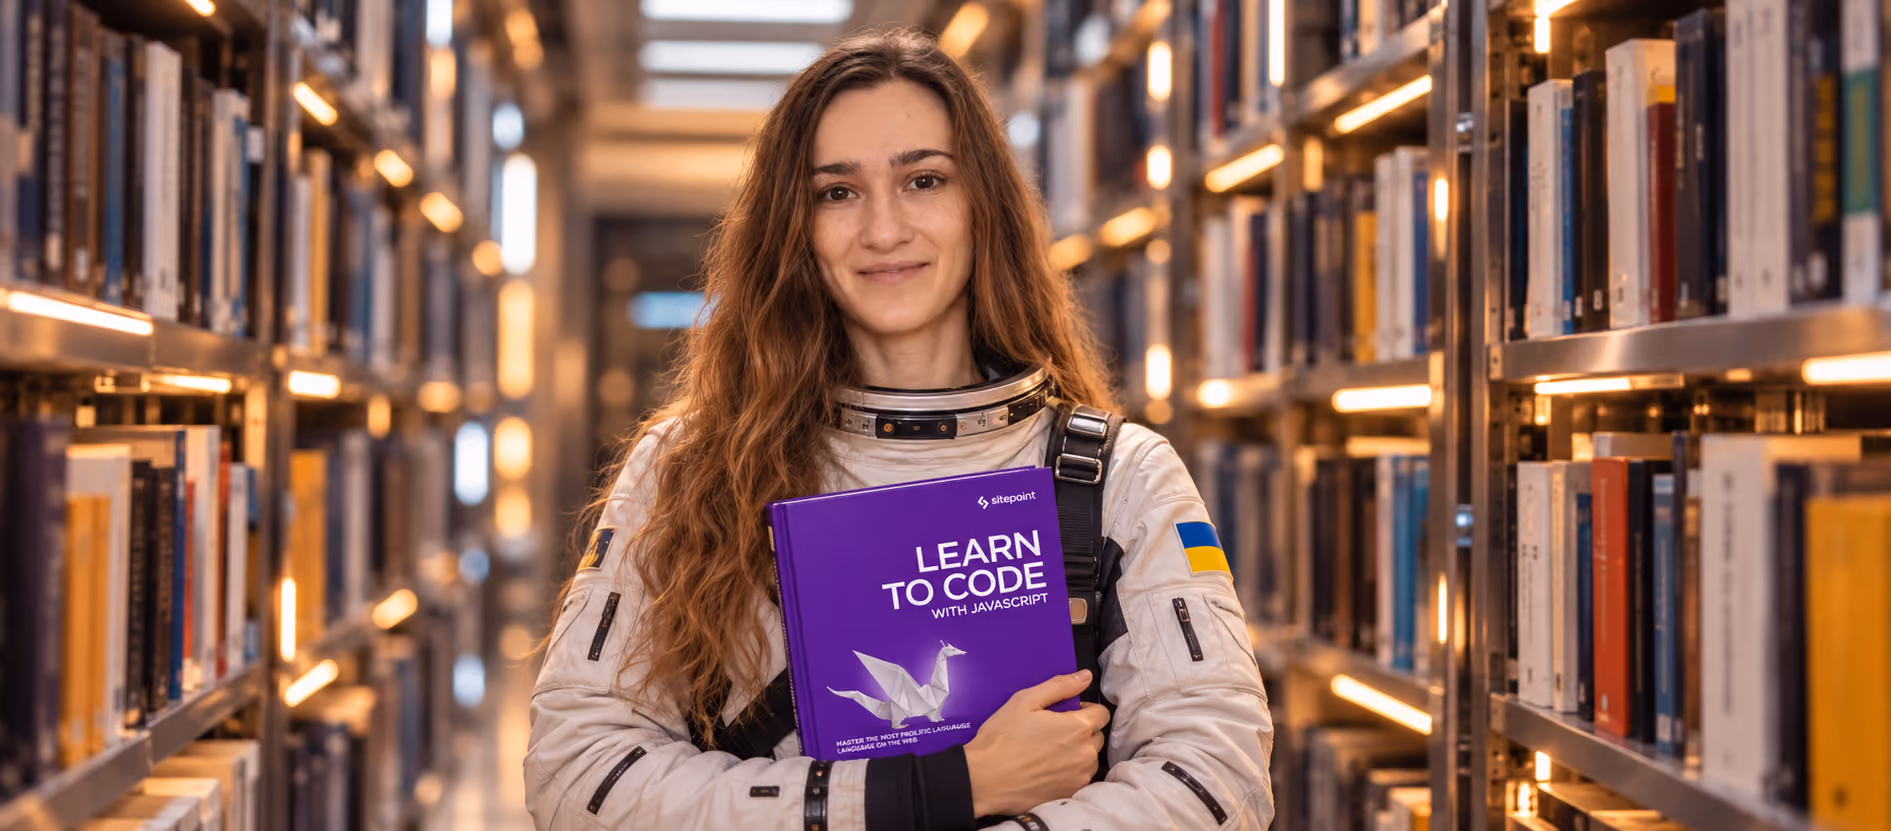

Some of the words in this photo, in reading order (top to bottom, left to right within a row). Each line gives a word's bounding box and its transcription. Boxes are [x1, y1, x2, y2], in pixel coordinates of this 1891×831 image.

[991, 491, 1036, 505] sitepoint
[915, 529, 1042, 573] LEARN
[881, 578, 934, 610] TO
[943, 561, 1047, 601] CODE
[931, 604, 968, 619] WITH
[971, 592, 1048, 614] JAVASCRIPT
